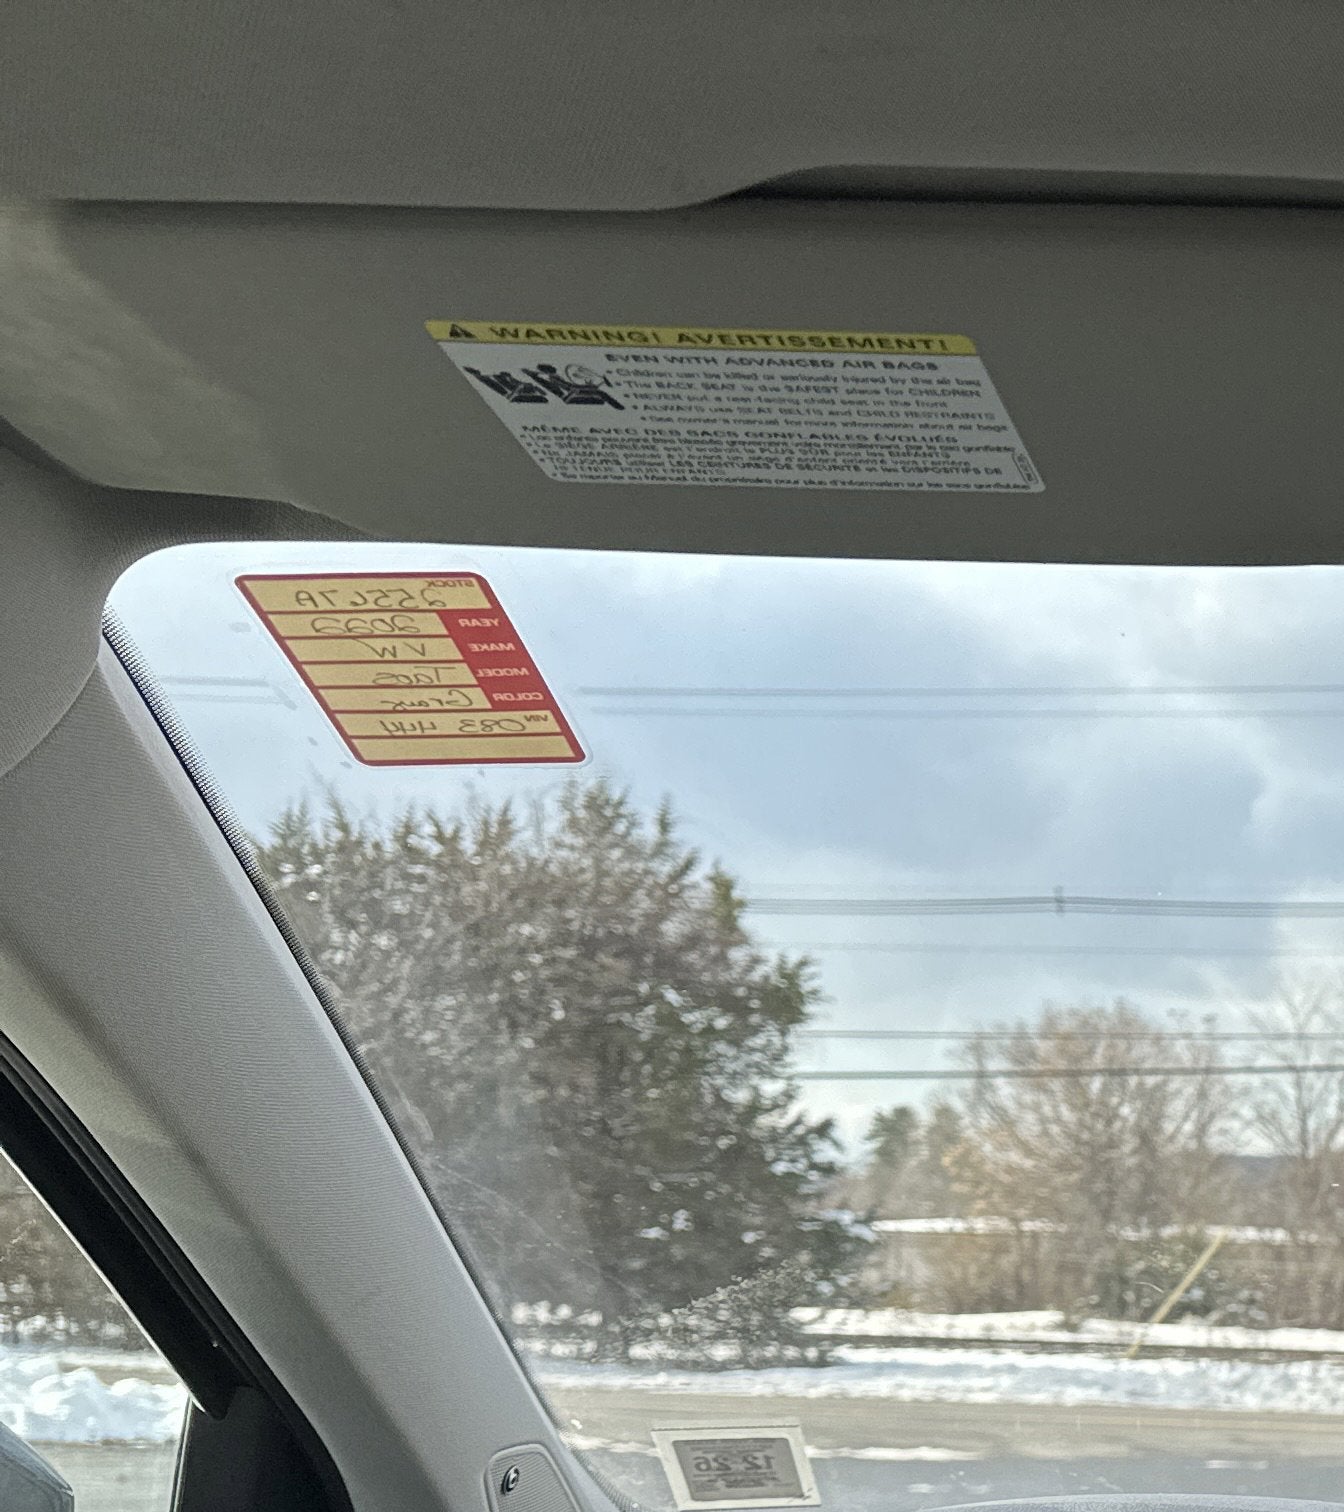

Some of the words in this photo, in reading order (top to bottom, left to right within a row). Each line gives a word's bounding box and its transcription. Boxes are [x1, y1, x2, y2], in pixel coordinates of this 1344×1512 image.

[490, 326, 661, 344] WARNING!
[676, 332, 948, 351] AVERTISSEMENT!
[605, 353, 659, 364] EVEN
[664, 355, 719, 366] WITH
[725, 356, 834, 369] ADVANCED
[842, 359, 876, 370] AIR
[882, 361, 938, 371] BAGS
